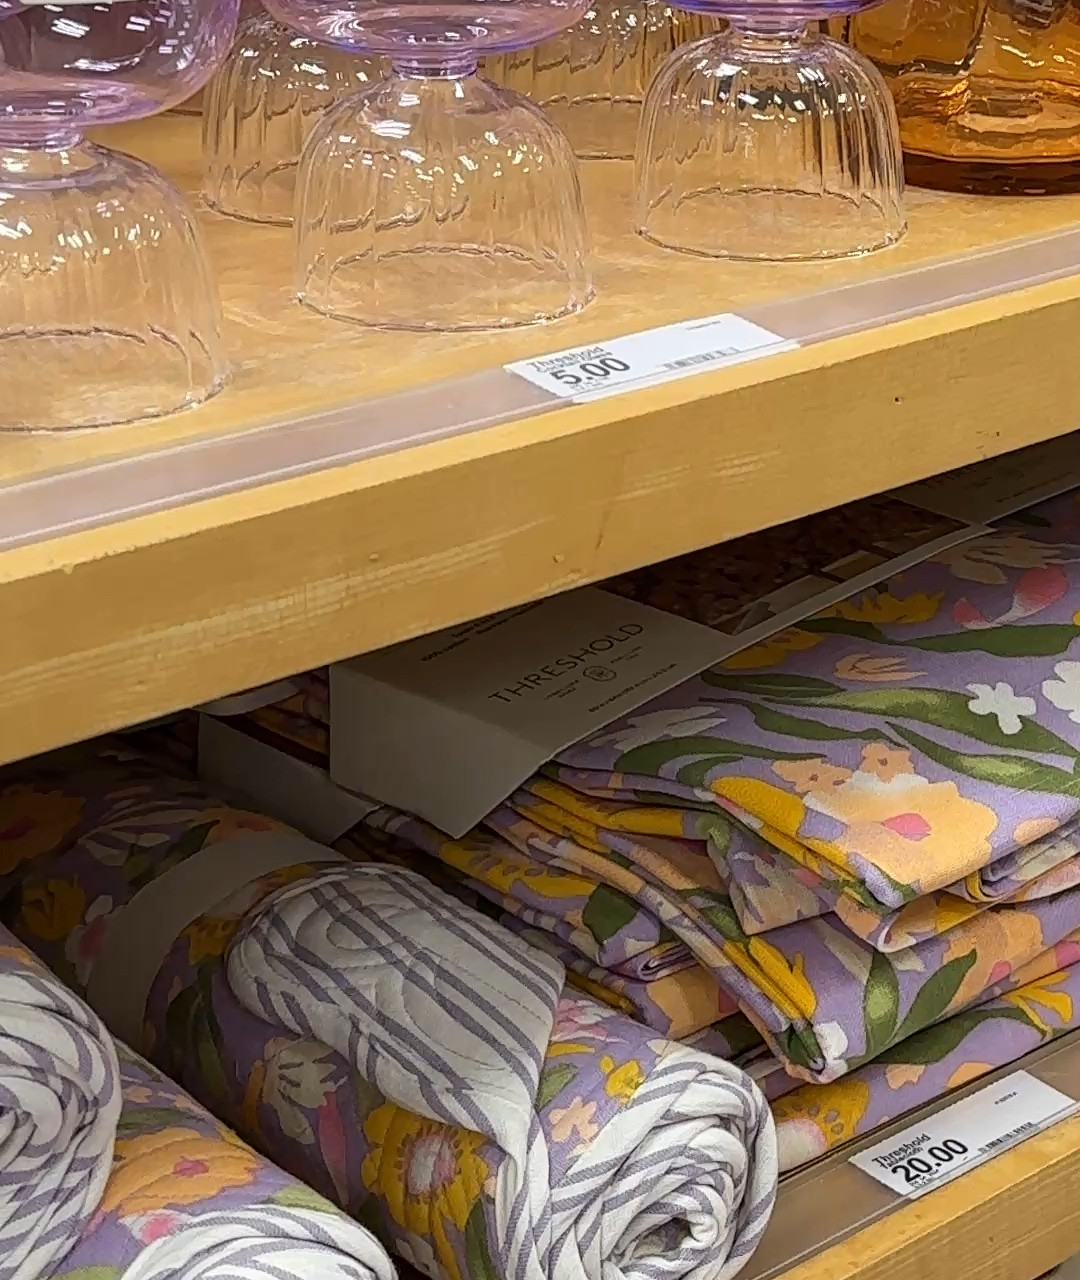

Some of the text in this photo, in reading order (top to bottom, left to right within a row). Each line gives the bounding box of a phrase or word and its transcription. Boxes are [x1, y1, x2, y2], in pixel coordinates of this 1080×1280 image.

[550, 357, 632, 386] 5.00
[488, 622, 644, 704] THRESHOLD
[872, 1132, 932, 1170] Threshold
[891, 1138, 969, 1184] 20.00
